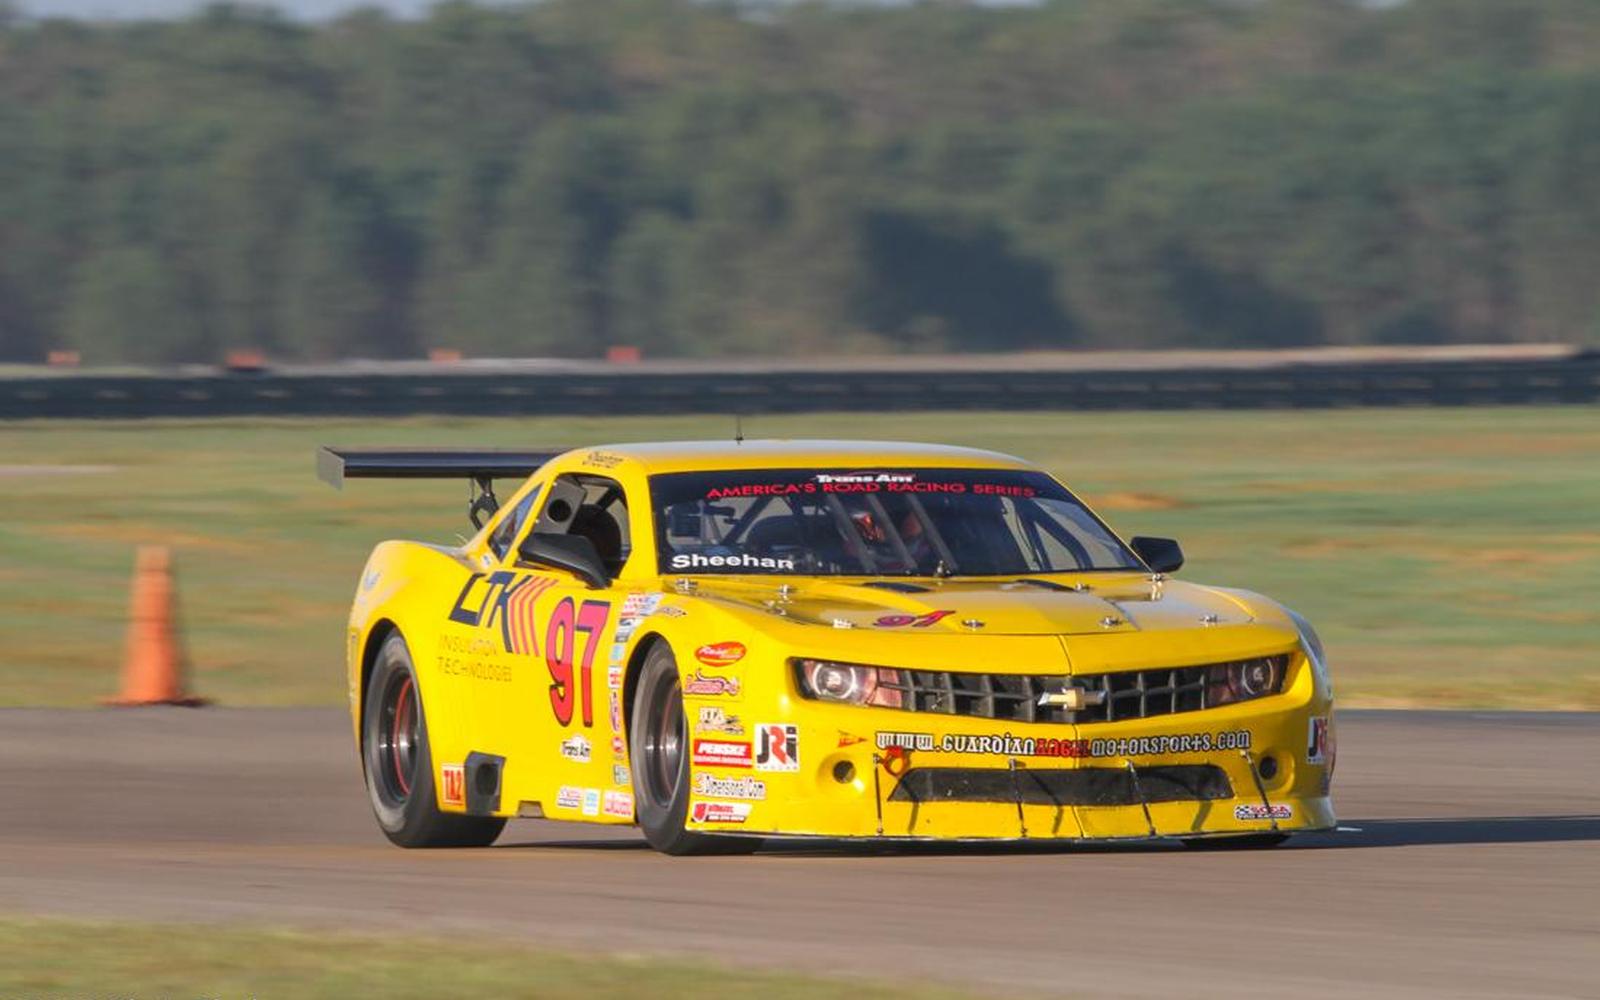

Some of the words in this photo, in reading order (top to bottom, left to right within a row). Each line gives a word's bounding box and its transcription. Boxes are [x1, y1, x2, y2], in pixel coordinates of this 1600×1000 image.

[816, 474, 874, 483] Trans
[876, 474, 913, 483] Am
[706, 483, 817, 499] AMERICA'S
[823, 482, 880, 493] ROAD
[887, 482, 966, 494] RACING
[972, 484, 1036, 498] SERIES
[671, 553, 795, 570] Sheehan
[872, 610, 957, 627] 97
[545, 596, 611, 728] 97
[443, 769, 463, 801] TA2
